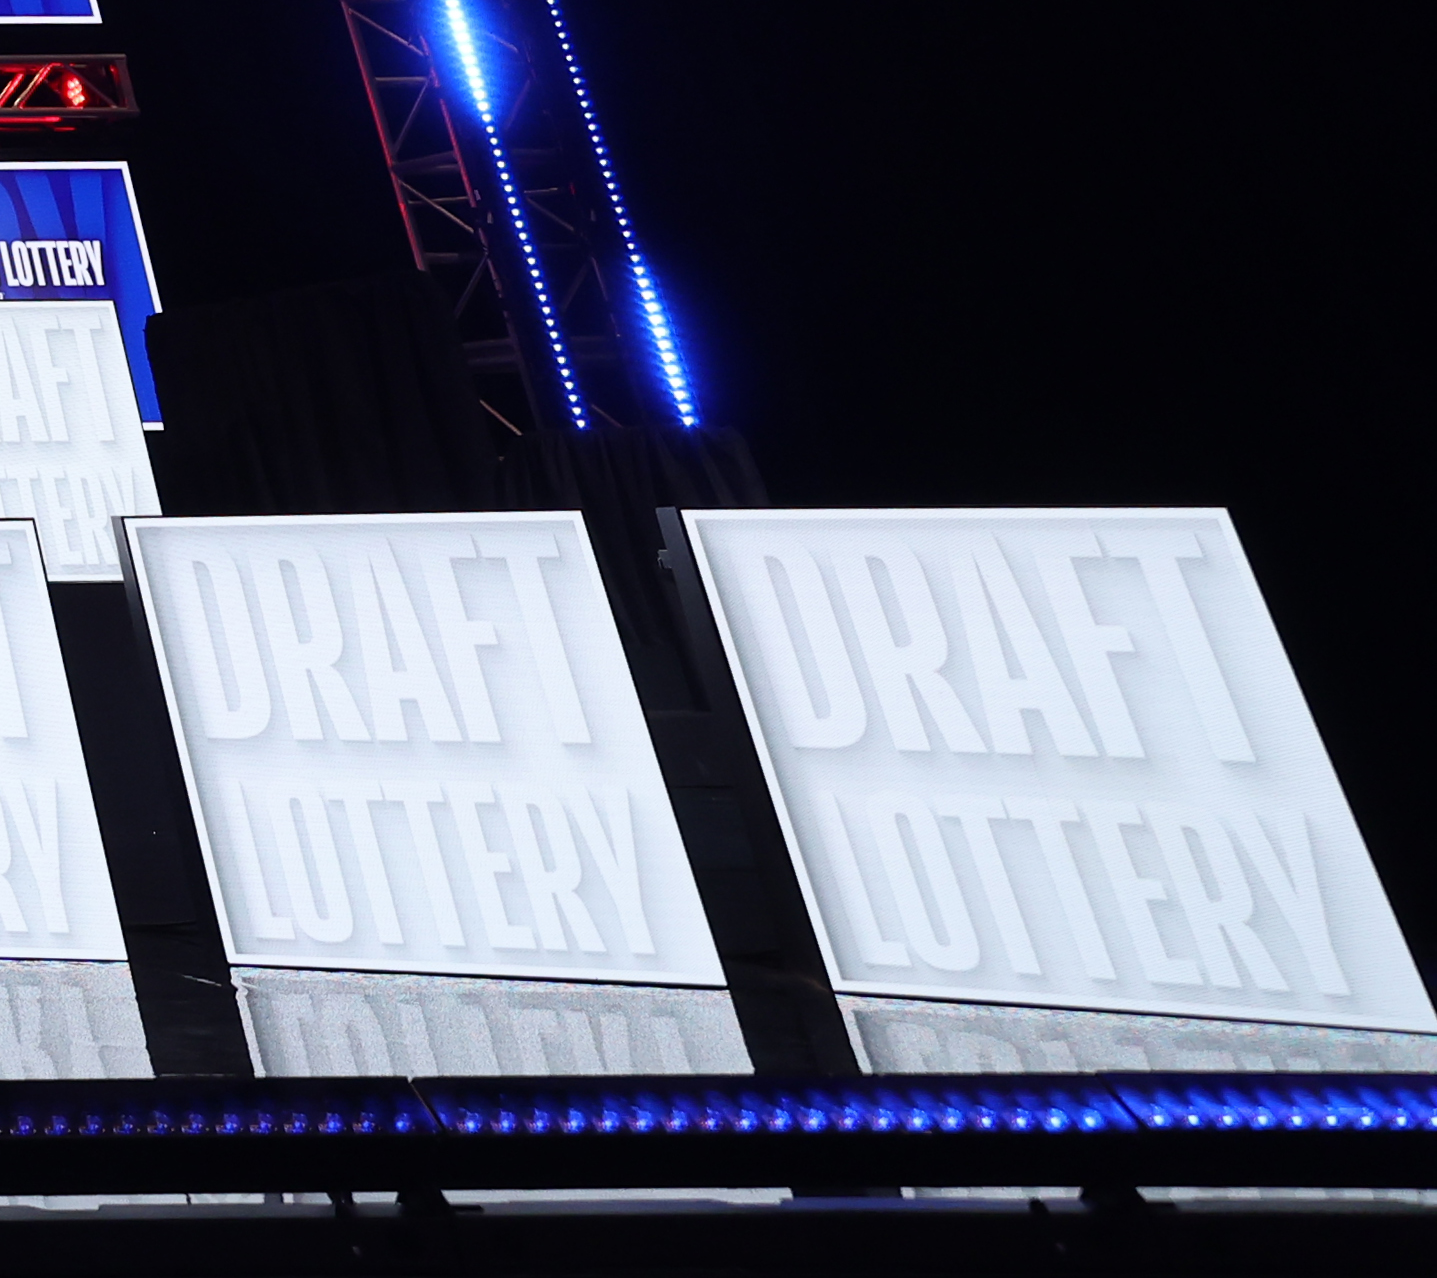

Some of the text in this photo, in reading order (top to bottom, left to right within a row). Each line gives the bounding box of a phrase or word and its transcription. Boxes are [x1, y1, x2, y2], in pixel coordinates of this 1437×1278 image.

[0, 240, 106, 287] LOTTERY
[169, 530, 592, 745] DRAFT
[728, 528, 1257, 764] DRAFT
[222, 776, 658, 956] LOTTERY
[816, 786, 1352, 998] LOTTERY
